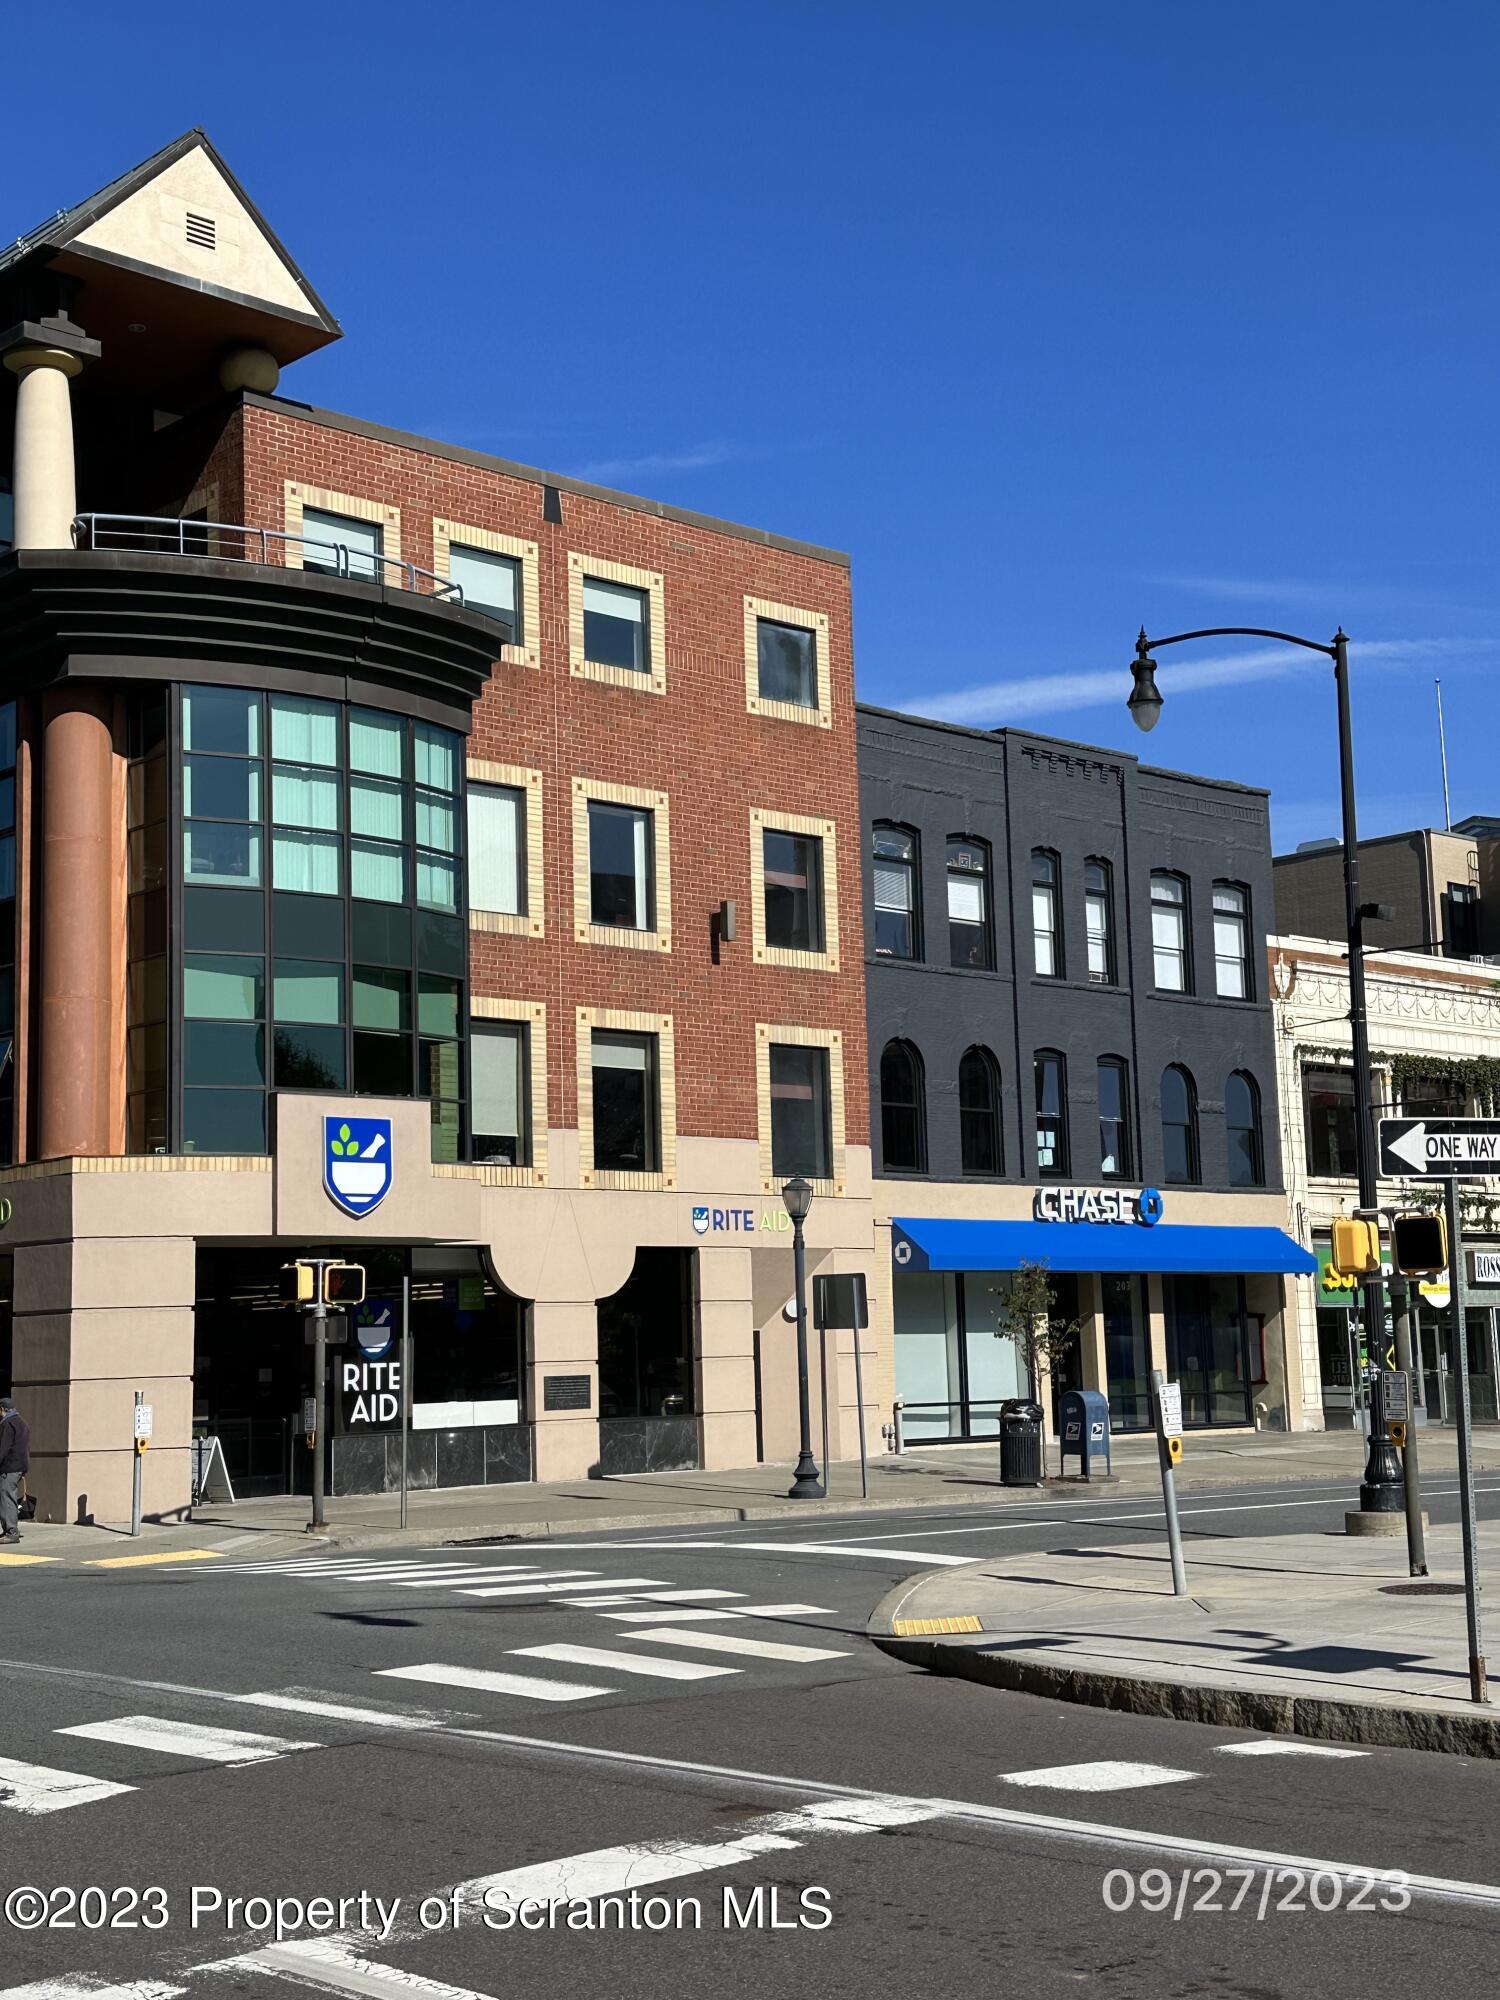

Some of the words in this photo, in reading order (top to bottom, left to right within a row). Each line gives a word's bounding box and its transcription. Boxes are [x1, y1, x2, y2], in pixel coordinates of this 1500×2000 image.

[1426, 1136, 1462, 1158] ONE
[1467, 1136, 1497, 1158] WAY
[1039, 1187, 1136, 1220] CHASE
[712, 1208, 755, 1232] RITE
[758, 1210, 791, 1232] AID
[343, 1363, 400, 1391] RITE
[350, 1394, 398, 1423] AID
